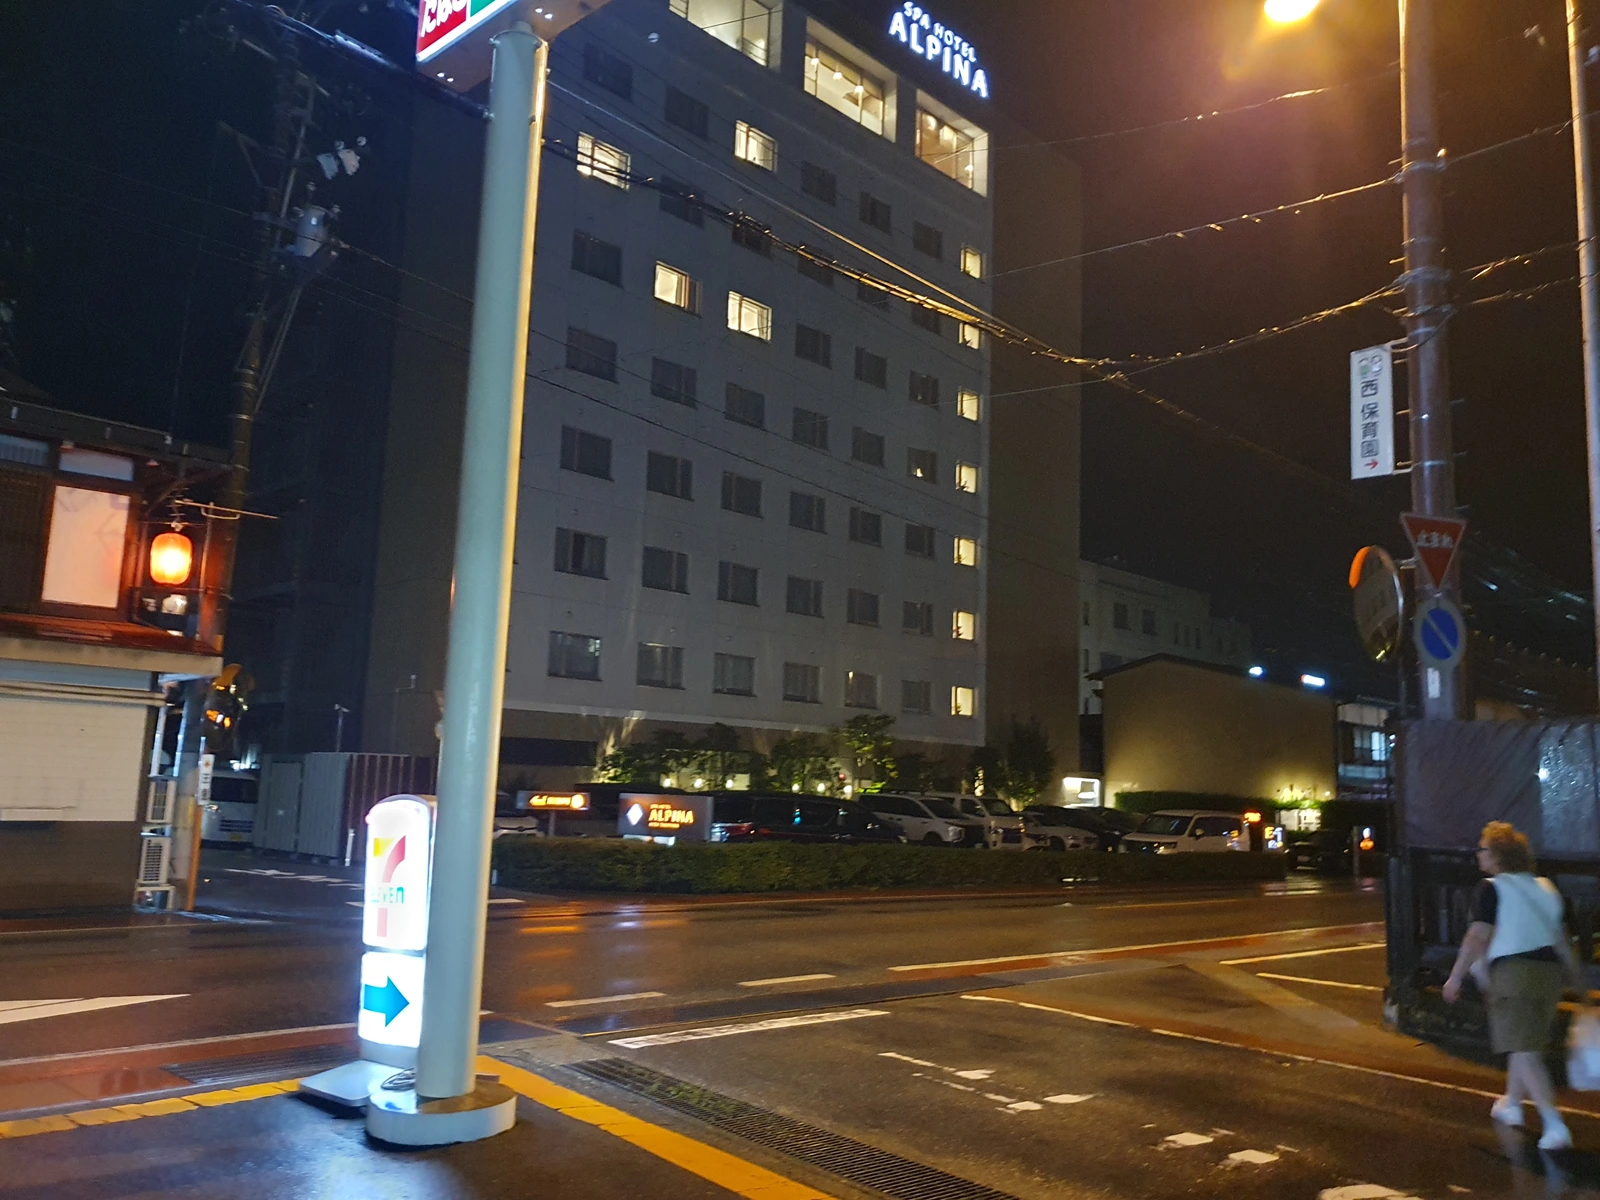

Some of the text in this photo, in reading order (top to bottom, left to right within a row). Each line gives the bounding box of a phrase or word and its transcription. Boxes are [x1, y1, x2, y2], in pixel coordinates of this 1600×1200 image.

[888, 11, 989, 98] ALPINA
[903, 1, 977, 62] SPA HOTEL
[648, 808, 694, 824] ALPINA
